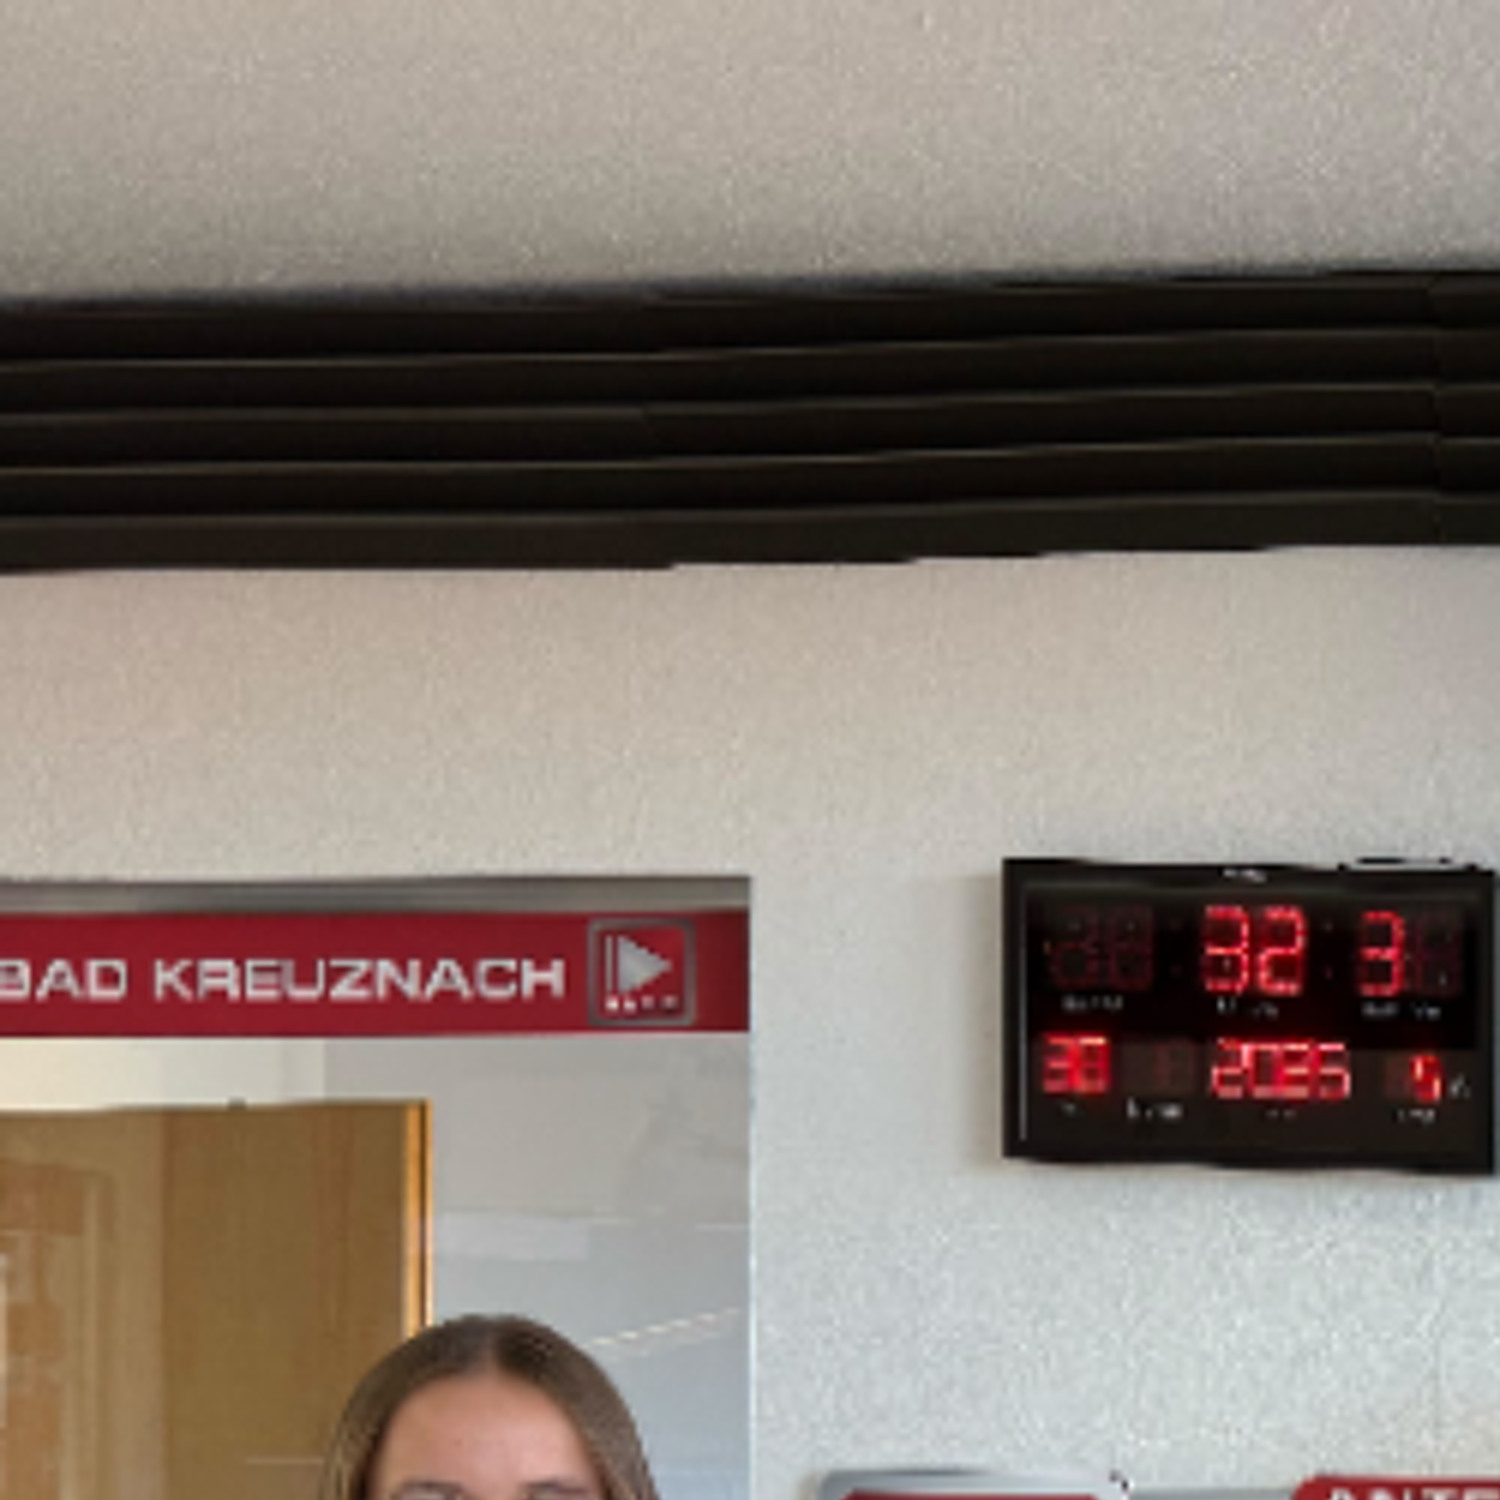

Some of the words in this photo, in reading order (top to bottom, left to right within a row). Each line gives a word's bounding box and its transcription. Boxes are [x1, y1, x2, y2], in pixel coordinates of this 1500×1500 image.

[0, 957, 128, 1001] BAD
[154, 957, 567, 1001] KREUZNACH
[1204, 905, 1308, 996] 32
